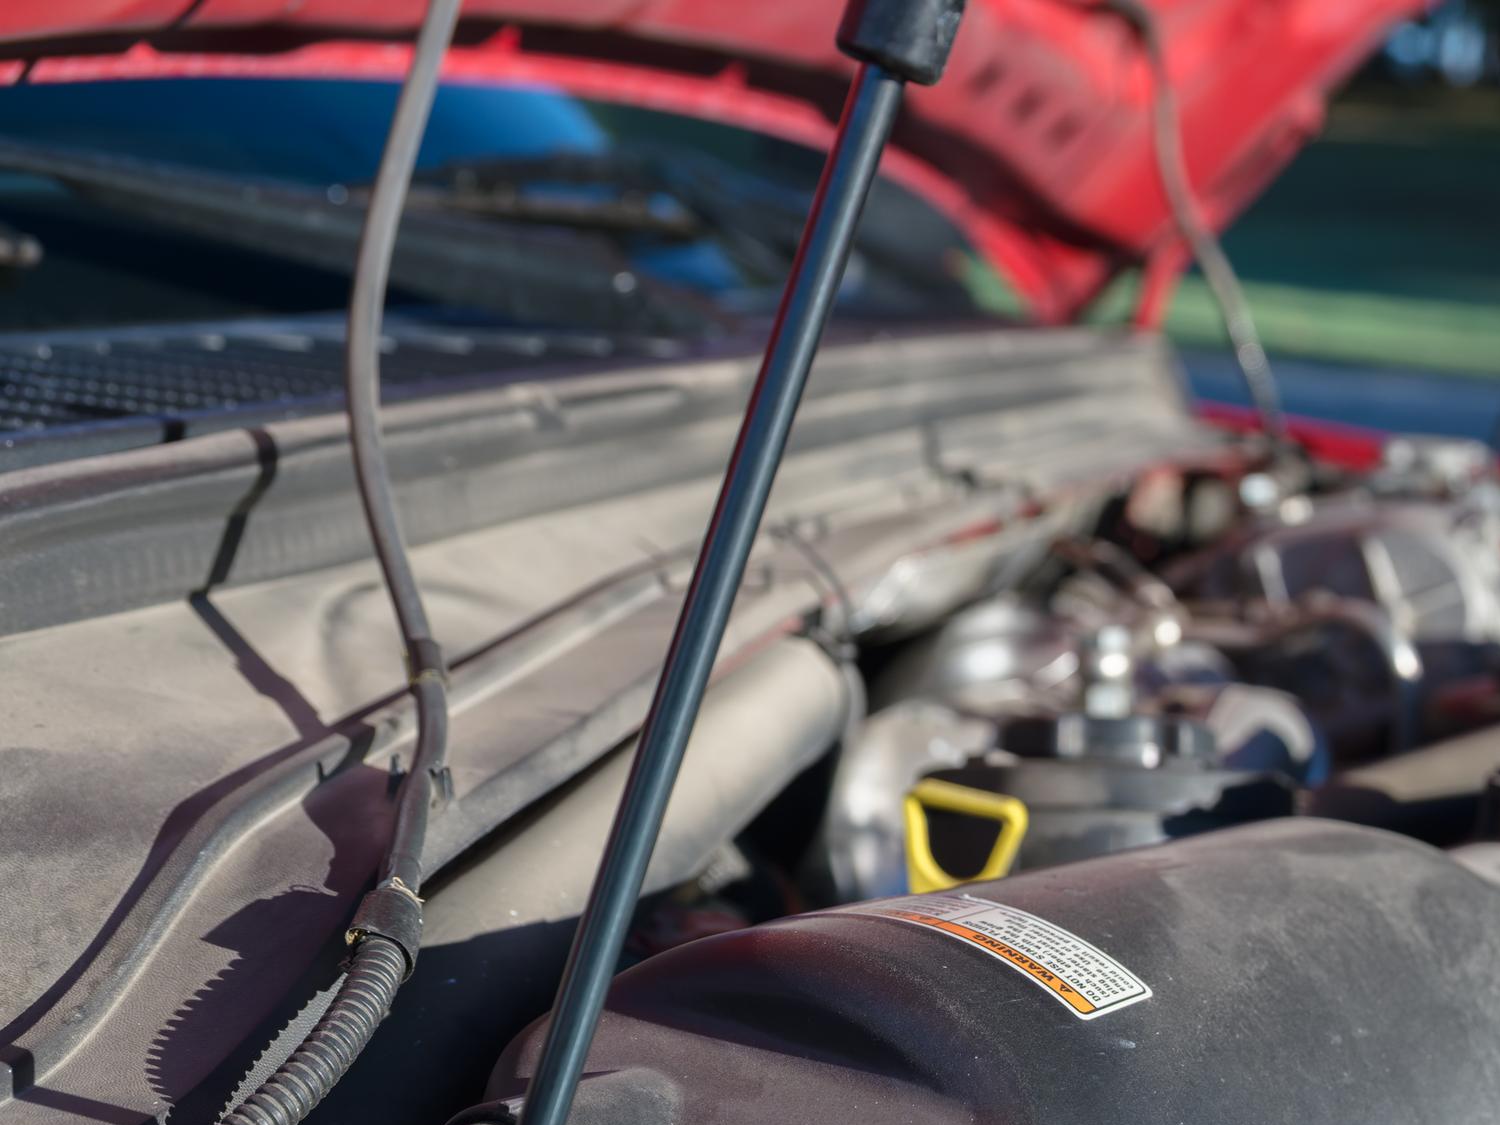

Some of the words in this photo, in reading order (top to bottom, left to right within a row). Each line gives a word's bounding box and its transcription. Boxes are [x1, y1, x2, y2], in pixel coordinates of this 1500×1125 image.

[1000, 935, 1045, 960] STARTER
[1021, 938, 1042, 950] with
[972, 934, 1054, 982] WARNING
[1072, 953, 1091, 966] Use
[1044, 960, 1065, 974] USE
[1066, 957, 1098, 978] starter
[1064, 974, 1086, 990] NOT
[1098, 978, 1119, 996] plug
[1109, 970, 1134, 989] could
[1086, 990, 1101, 1002] DO
